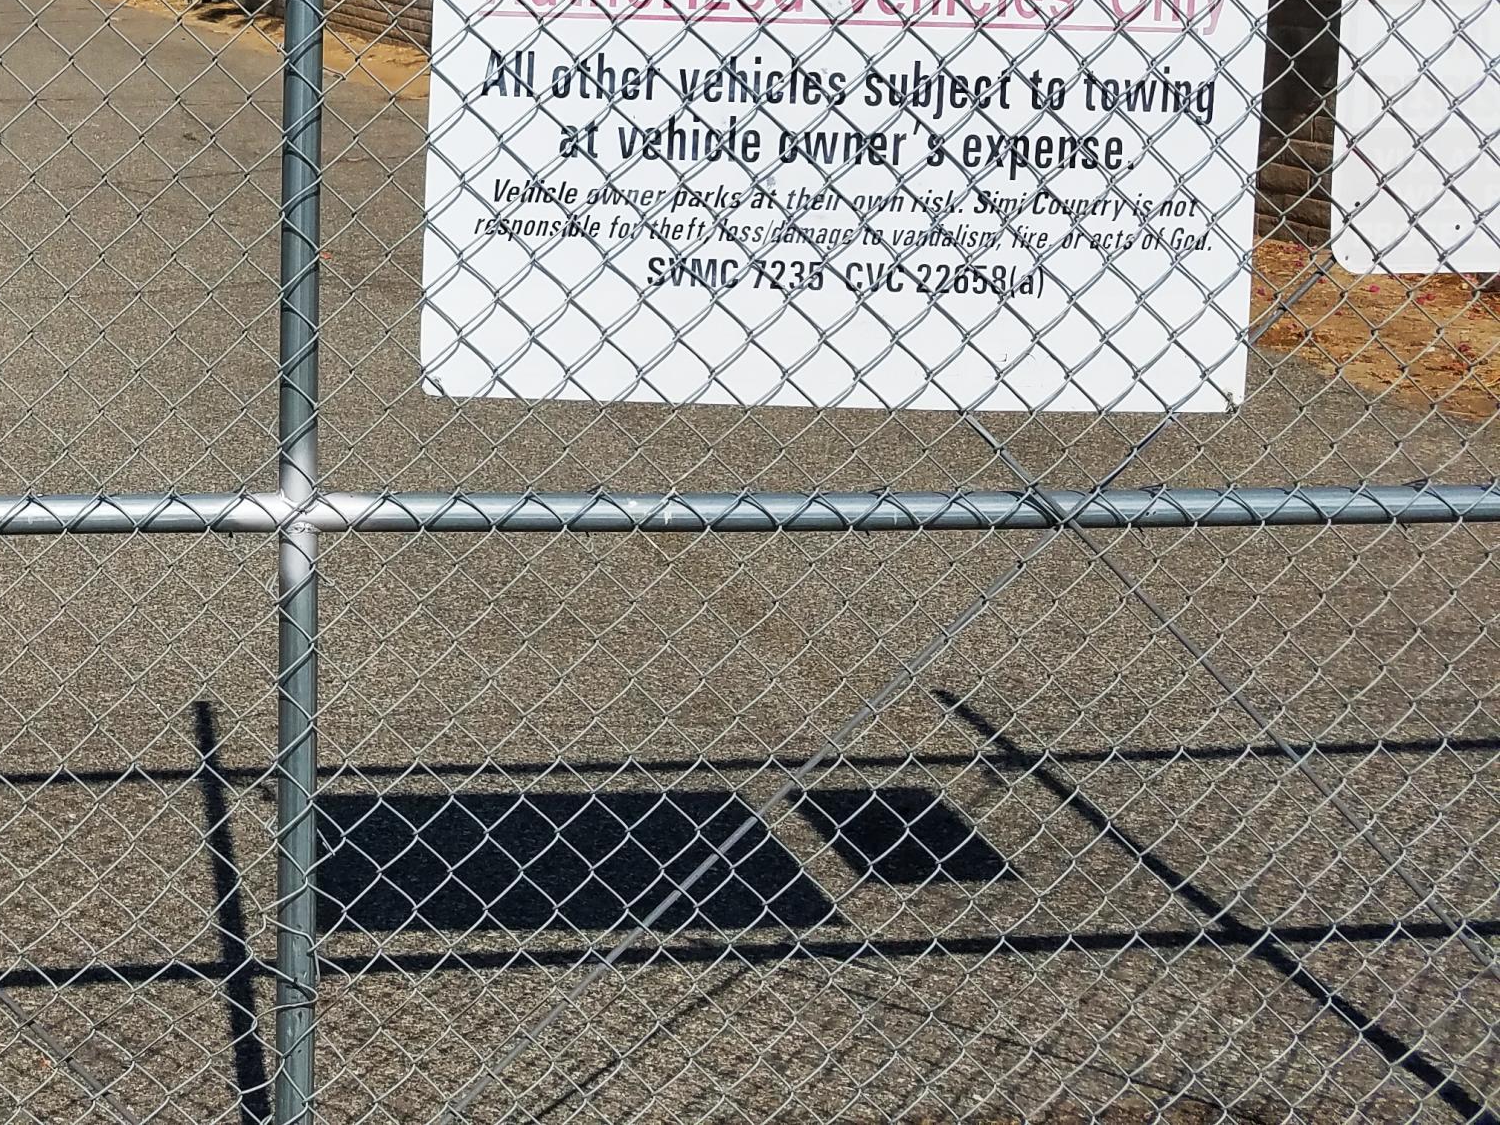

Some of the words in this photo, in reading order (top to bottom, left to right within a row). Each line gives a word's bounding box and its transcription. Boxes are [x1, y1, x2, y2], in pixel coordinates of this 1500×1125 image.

[481, 49, 535, 97] All
[552, 53, 659, 101] other
[680, 55, 847, 106] vehicles
[864, 61, 1011, 120] subject
[1030, 69, 1065, 110] to
[1084, 66, 1215, 125] towing
[559, 120, 598, 159] at
[618, 115, 761, 163] vehicle
[778, 119, 945, 167] owner's
[962, 133, 1135, 181] expense.
[493, 179, 578, 205] Vehicle
[586, 186, 667, 207] owner
[671, 185, 742, 213] parks
[751, 188, 777, 209] at
[786, 187, 843, 211] their
[853, 193, 906, 212] own
[910, 189, 964, 214] risk.
[973, 190, 1027, 215] Simi
[1032, 191, 1127, 221] Country
[1132, 193, 1154, 216] is
[1159, 195, 1200, 217] not
[474, 215, 601, 241] responsible
[608, 216, 642, 240] for
[861, 226, 884, 246] to
[892, 225, 1002, 251] vandalism,
[1061, 232, 1086, 250] or
[1089, 229, 1135, 250] acts
[1141, 227, 1167, 250] of
[1170, 227, 1213, 252] God.
[647, 257, 740, 288] SVMC
[752, 260, 825, 291] 7235
[845, 262, 905, 293] CVC
[916, 264, 1044, 299] 22658(a)
